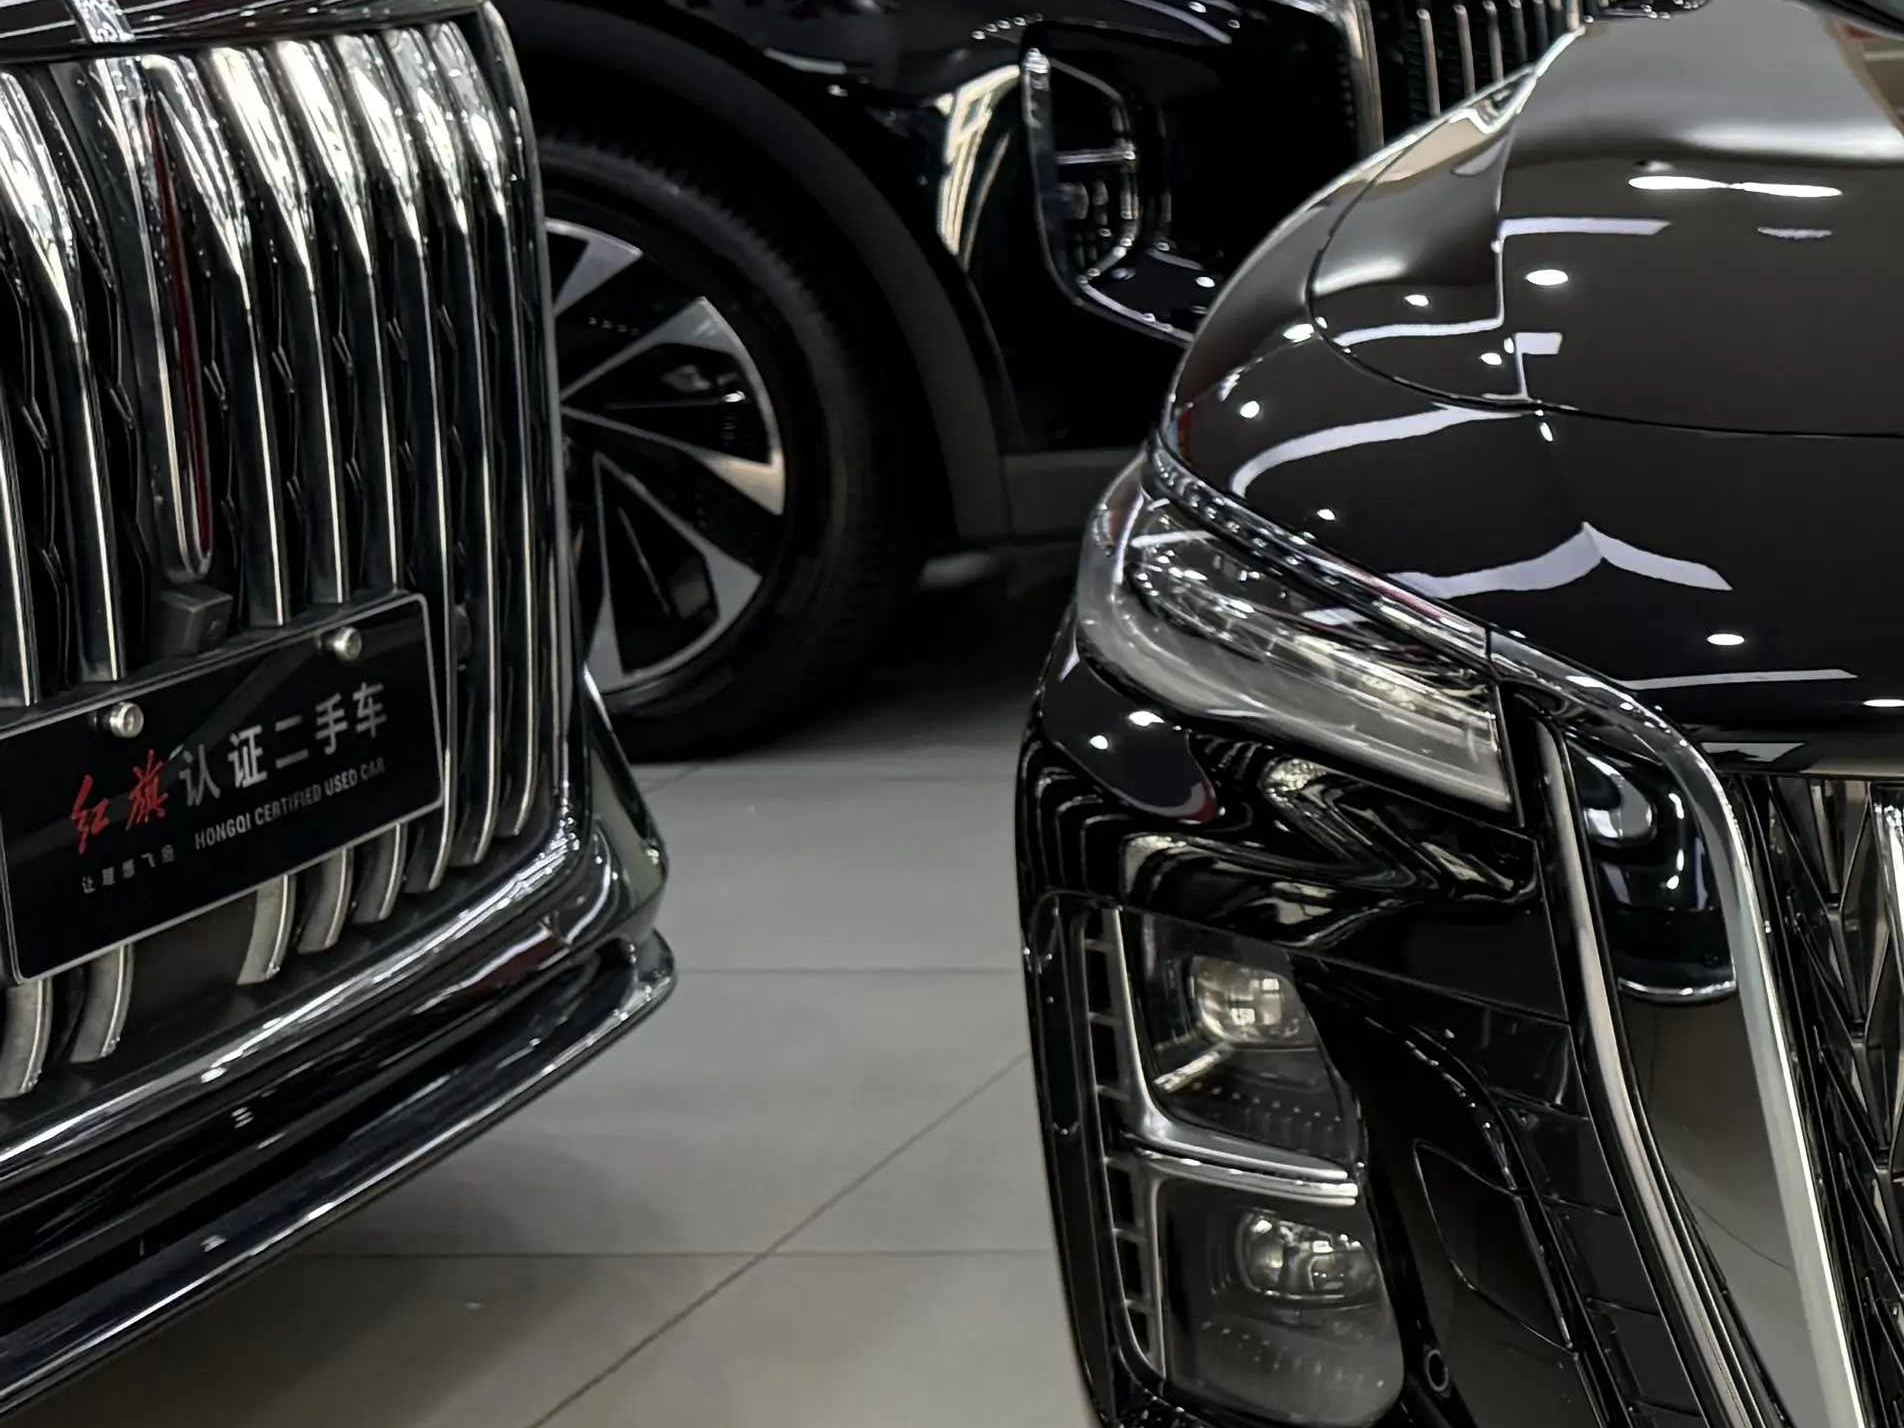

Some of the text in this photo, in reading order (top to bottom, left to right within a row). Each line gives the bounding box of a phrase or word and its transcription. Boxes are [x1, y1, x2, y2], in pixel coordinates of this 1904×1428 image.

[179, 681, 388, 808] 认证二手车
[195, 756, 386, 850] HONGQI CERTIFIED USED CAR
